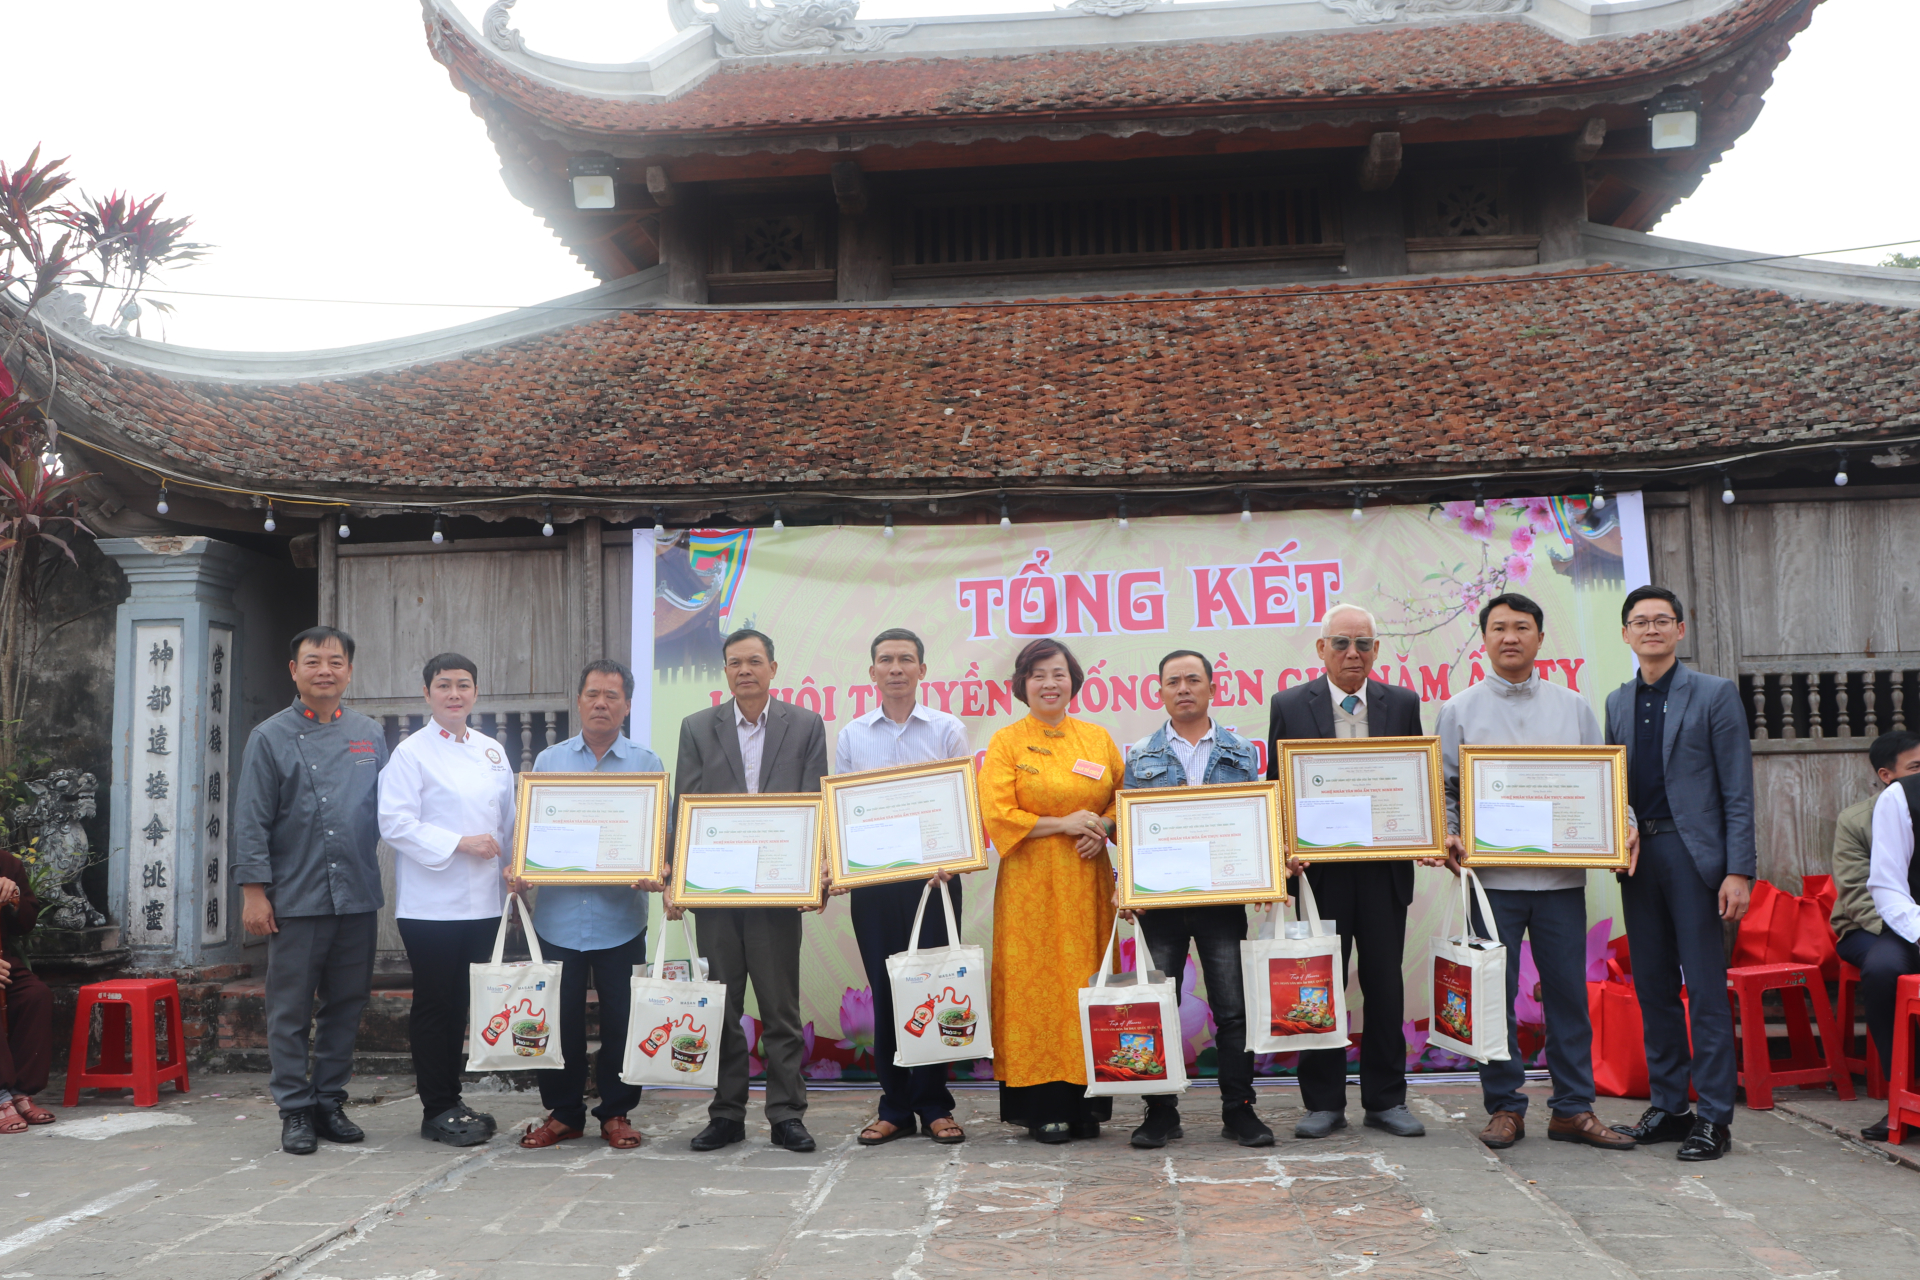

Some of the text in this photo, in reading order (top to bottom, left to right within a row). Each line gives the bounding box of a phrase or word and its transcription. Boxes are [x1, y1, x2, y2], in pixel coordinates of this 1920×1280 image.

[957, 540, 1341, 639] TỔNG KẾT
[848, 661, 1012, 719] TYỀN
[1068, 659, 1164, 714] ỐNG
[1211, 652, 1264, 707] ỀN
